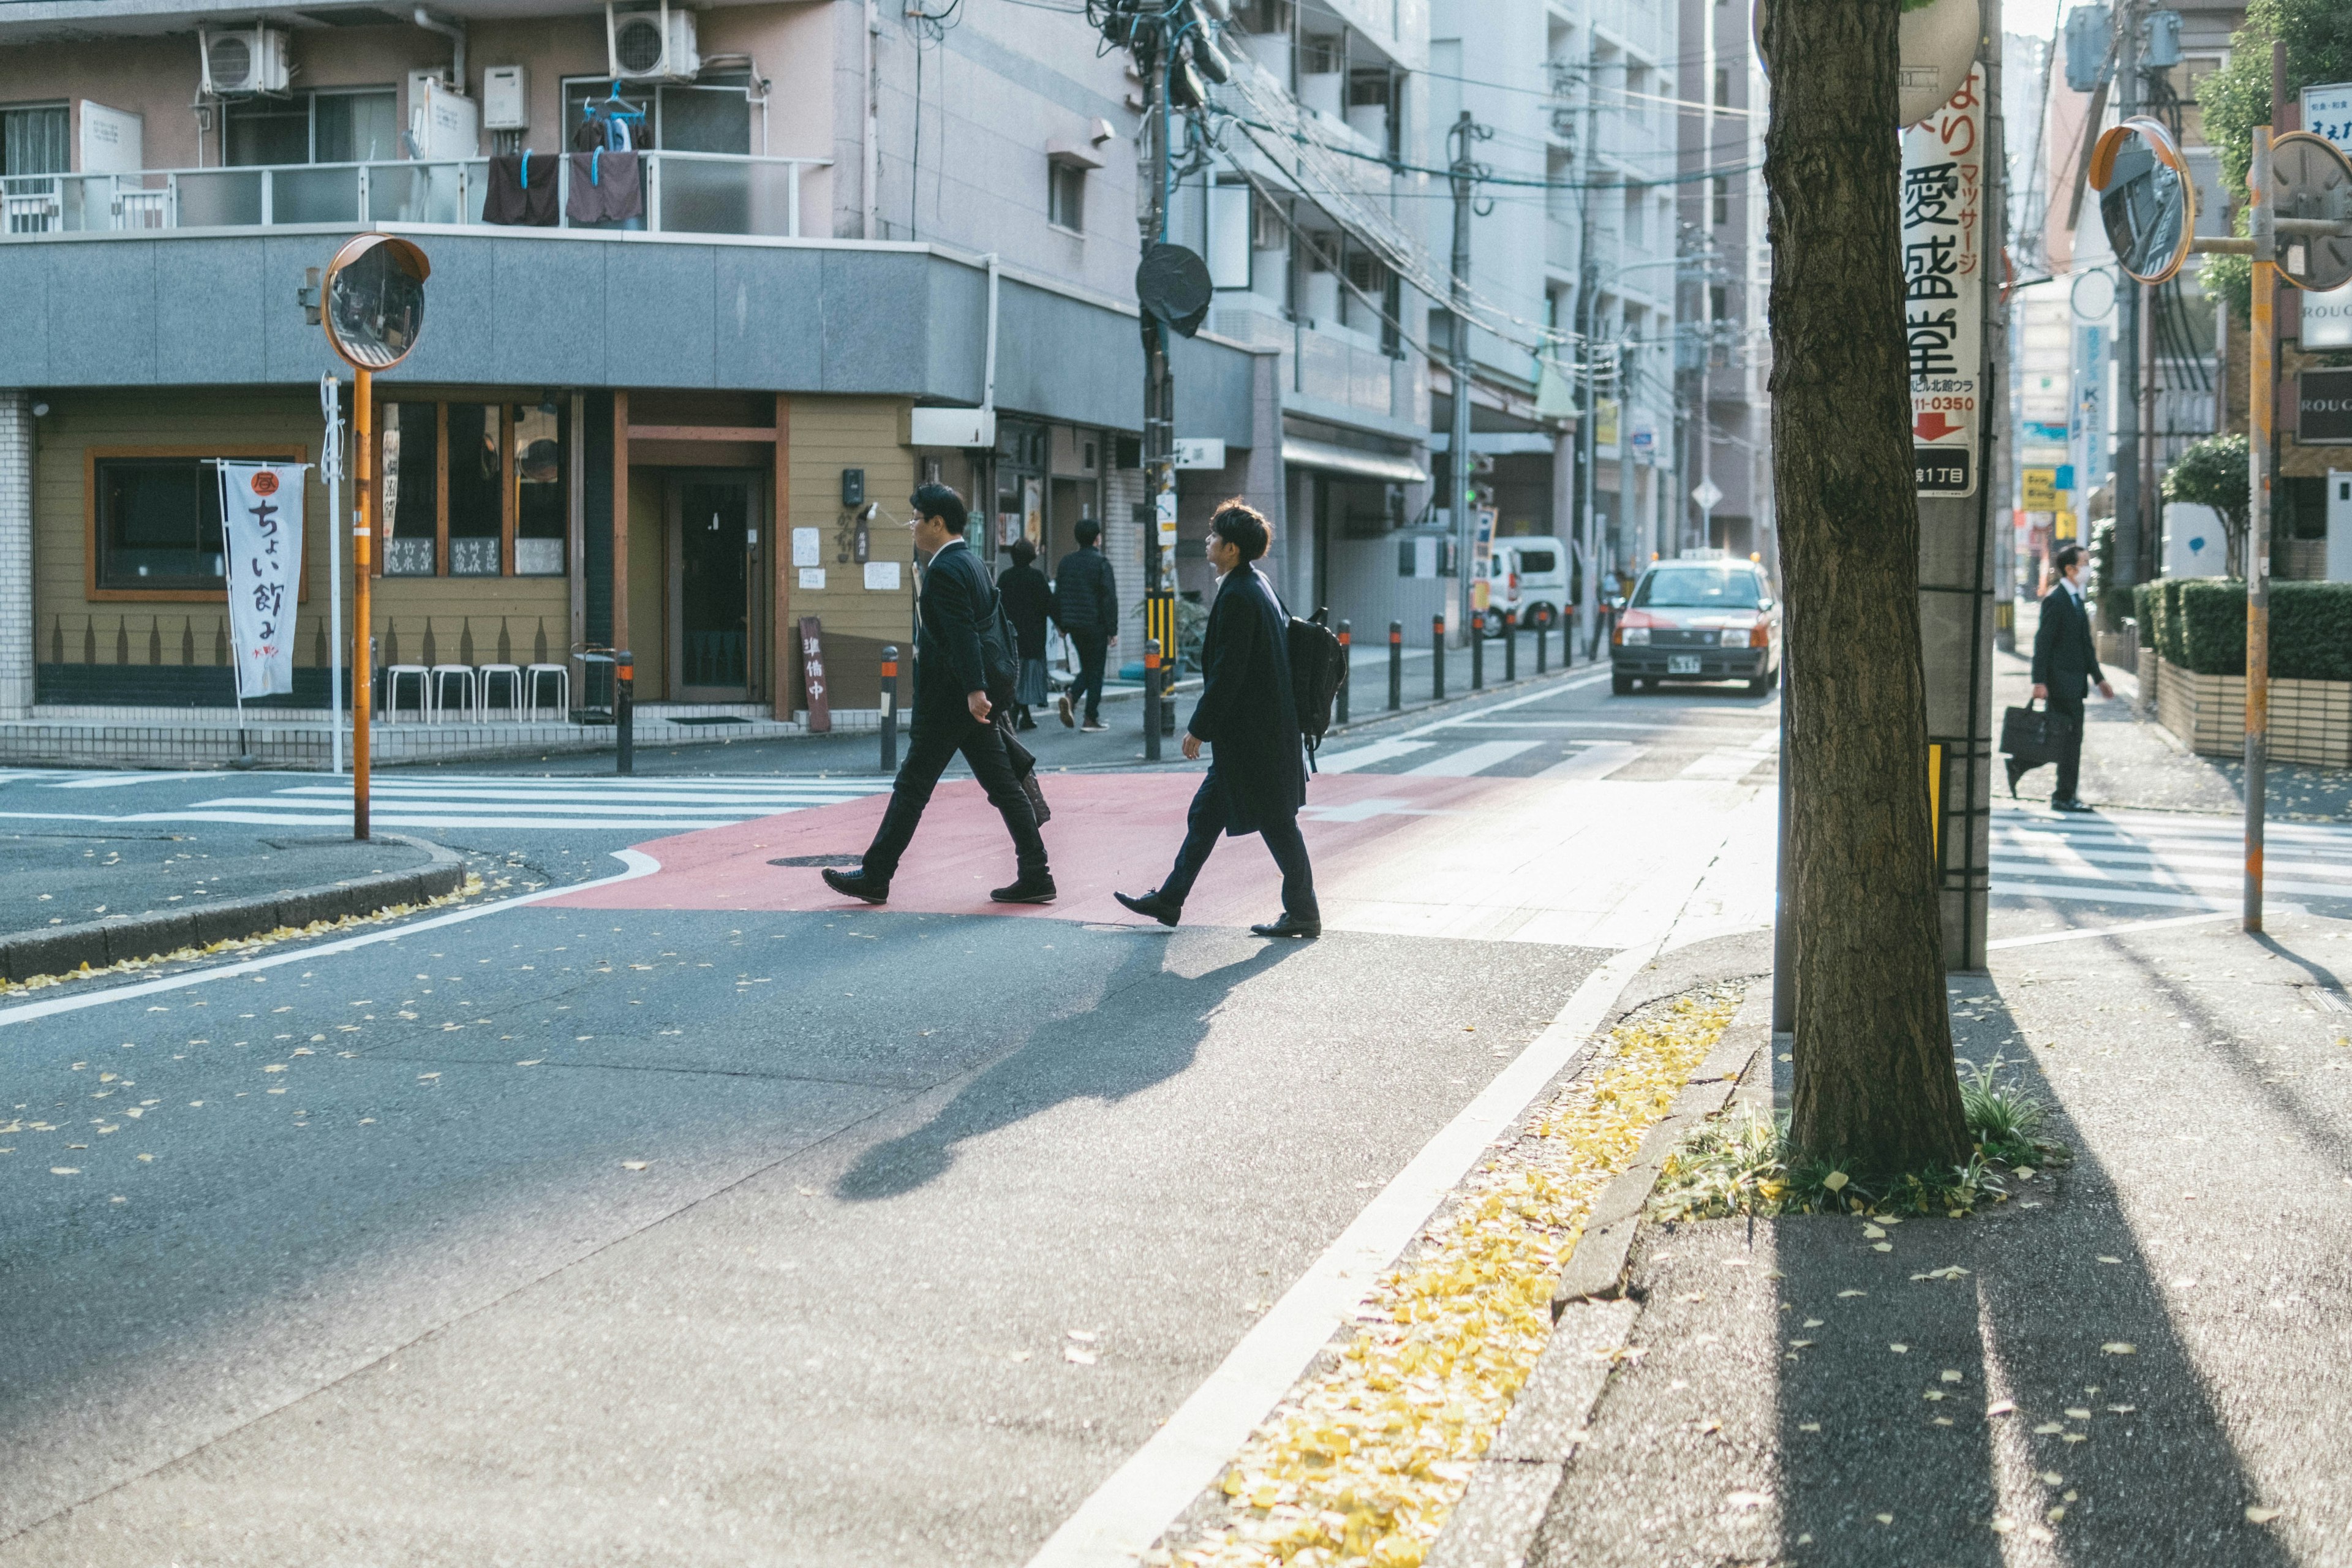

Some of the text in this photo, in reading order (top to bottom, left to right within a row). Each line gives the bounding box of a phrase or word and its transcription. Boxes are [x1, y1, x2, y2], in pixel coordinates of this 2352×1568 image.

[1904, 162, 1959, 375] 愛盛堂
[1959, 164, 1979, 274] マッサージ
[804, 636, 824, 701] 準備中
